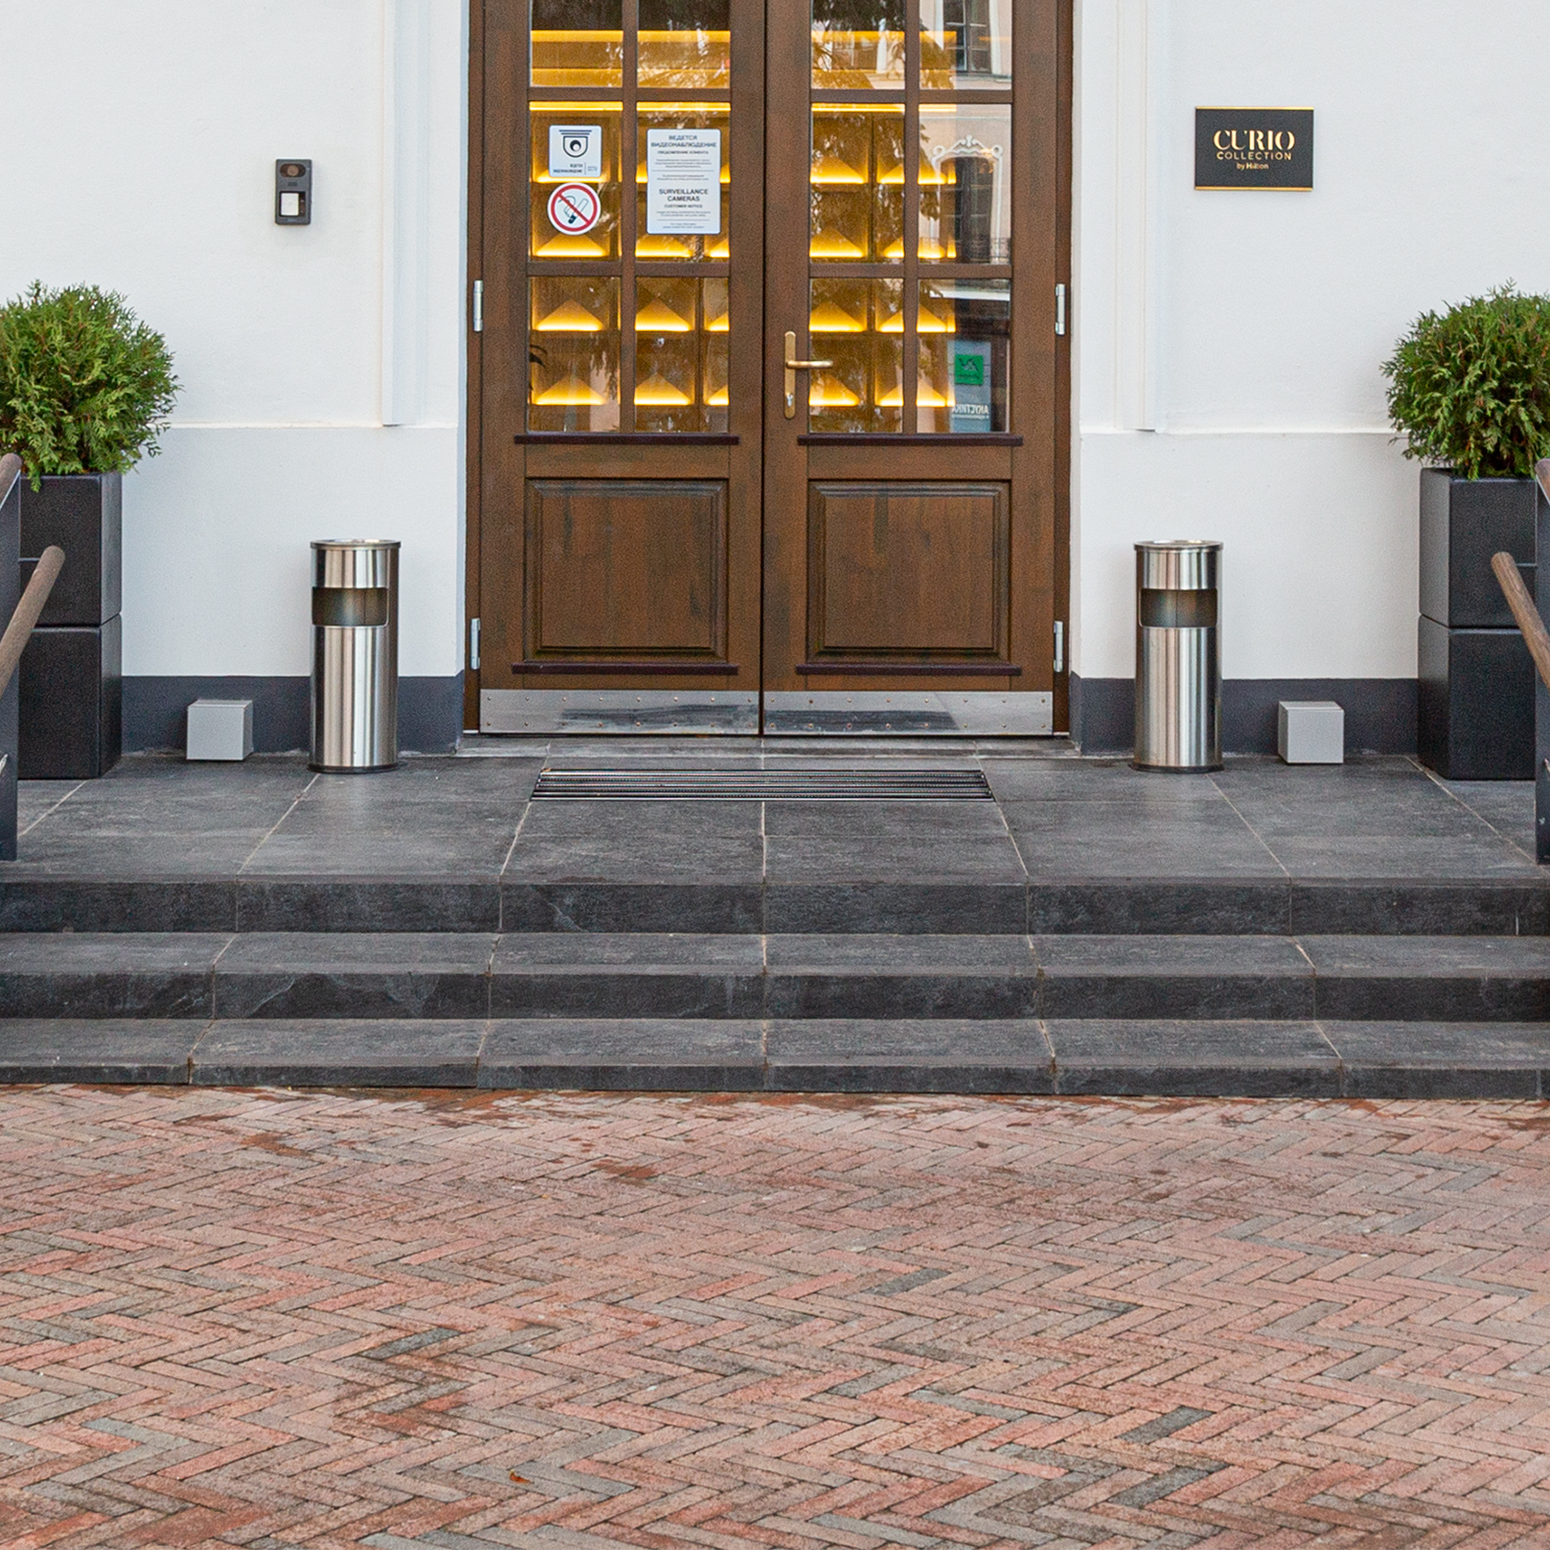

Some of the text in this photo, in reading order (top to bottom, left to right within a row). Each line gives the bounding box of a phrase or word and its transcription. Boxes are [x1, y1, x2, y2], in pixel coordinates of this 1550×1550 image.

[1213, 129, 1296, 151] CURIO
[1216, 151, 1292, 161] COLLECTION
[1246, 162, 1270, 170] Hilton
